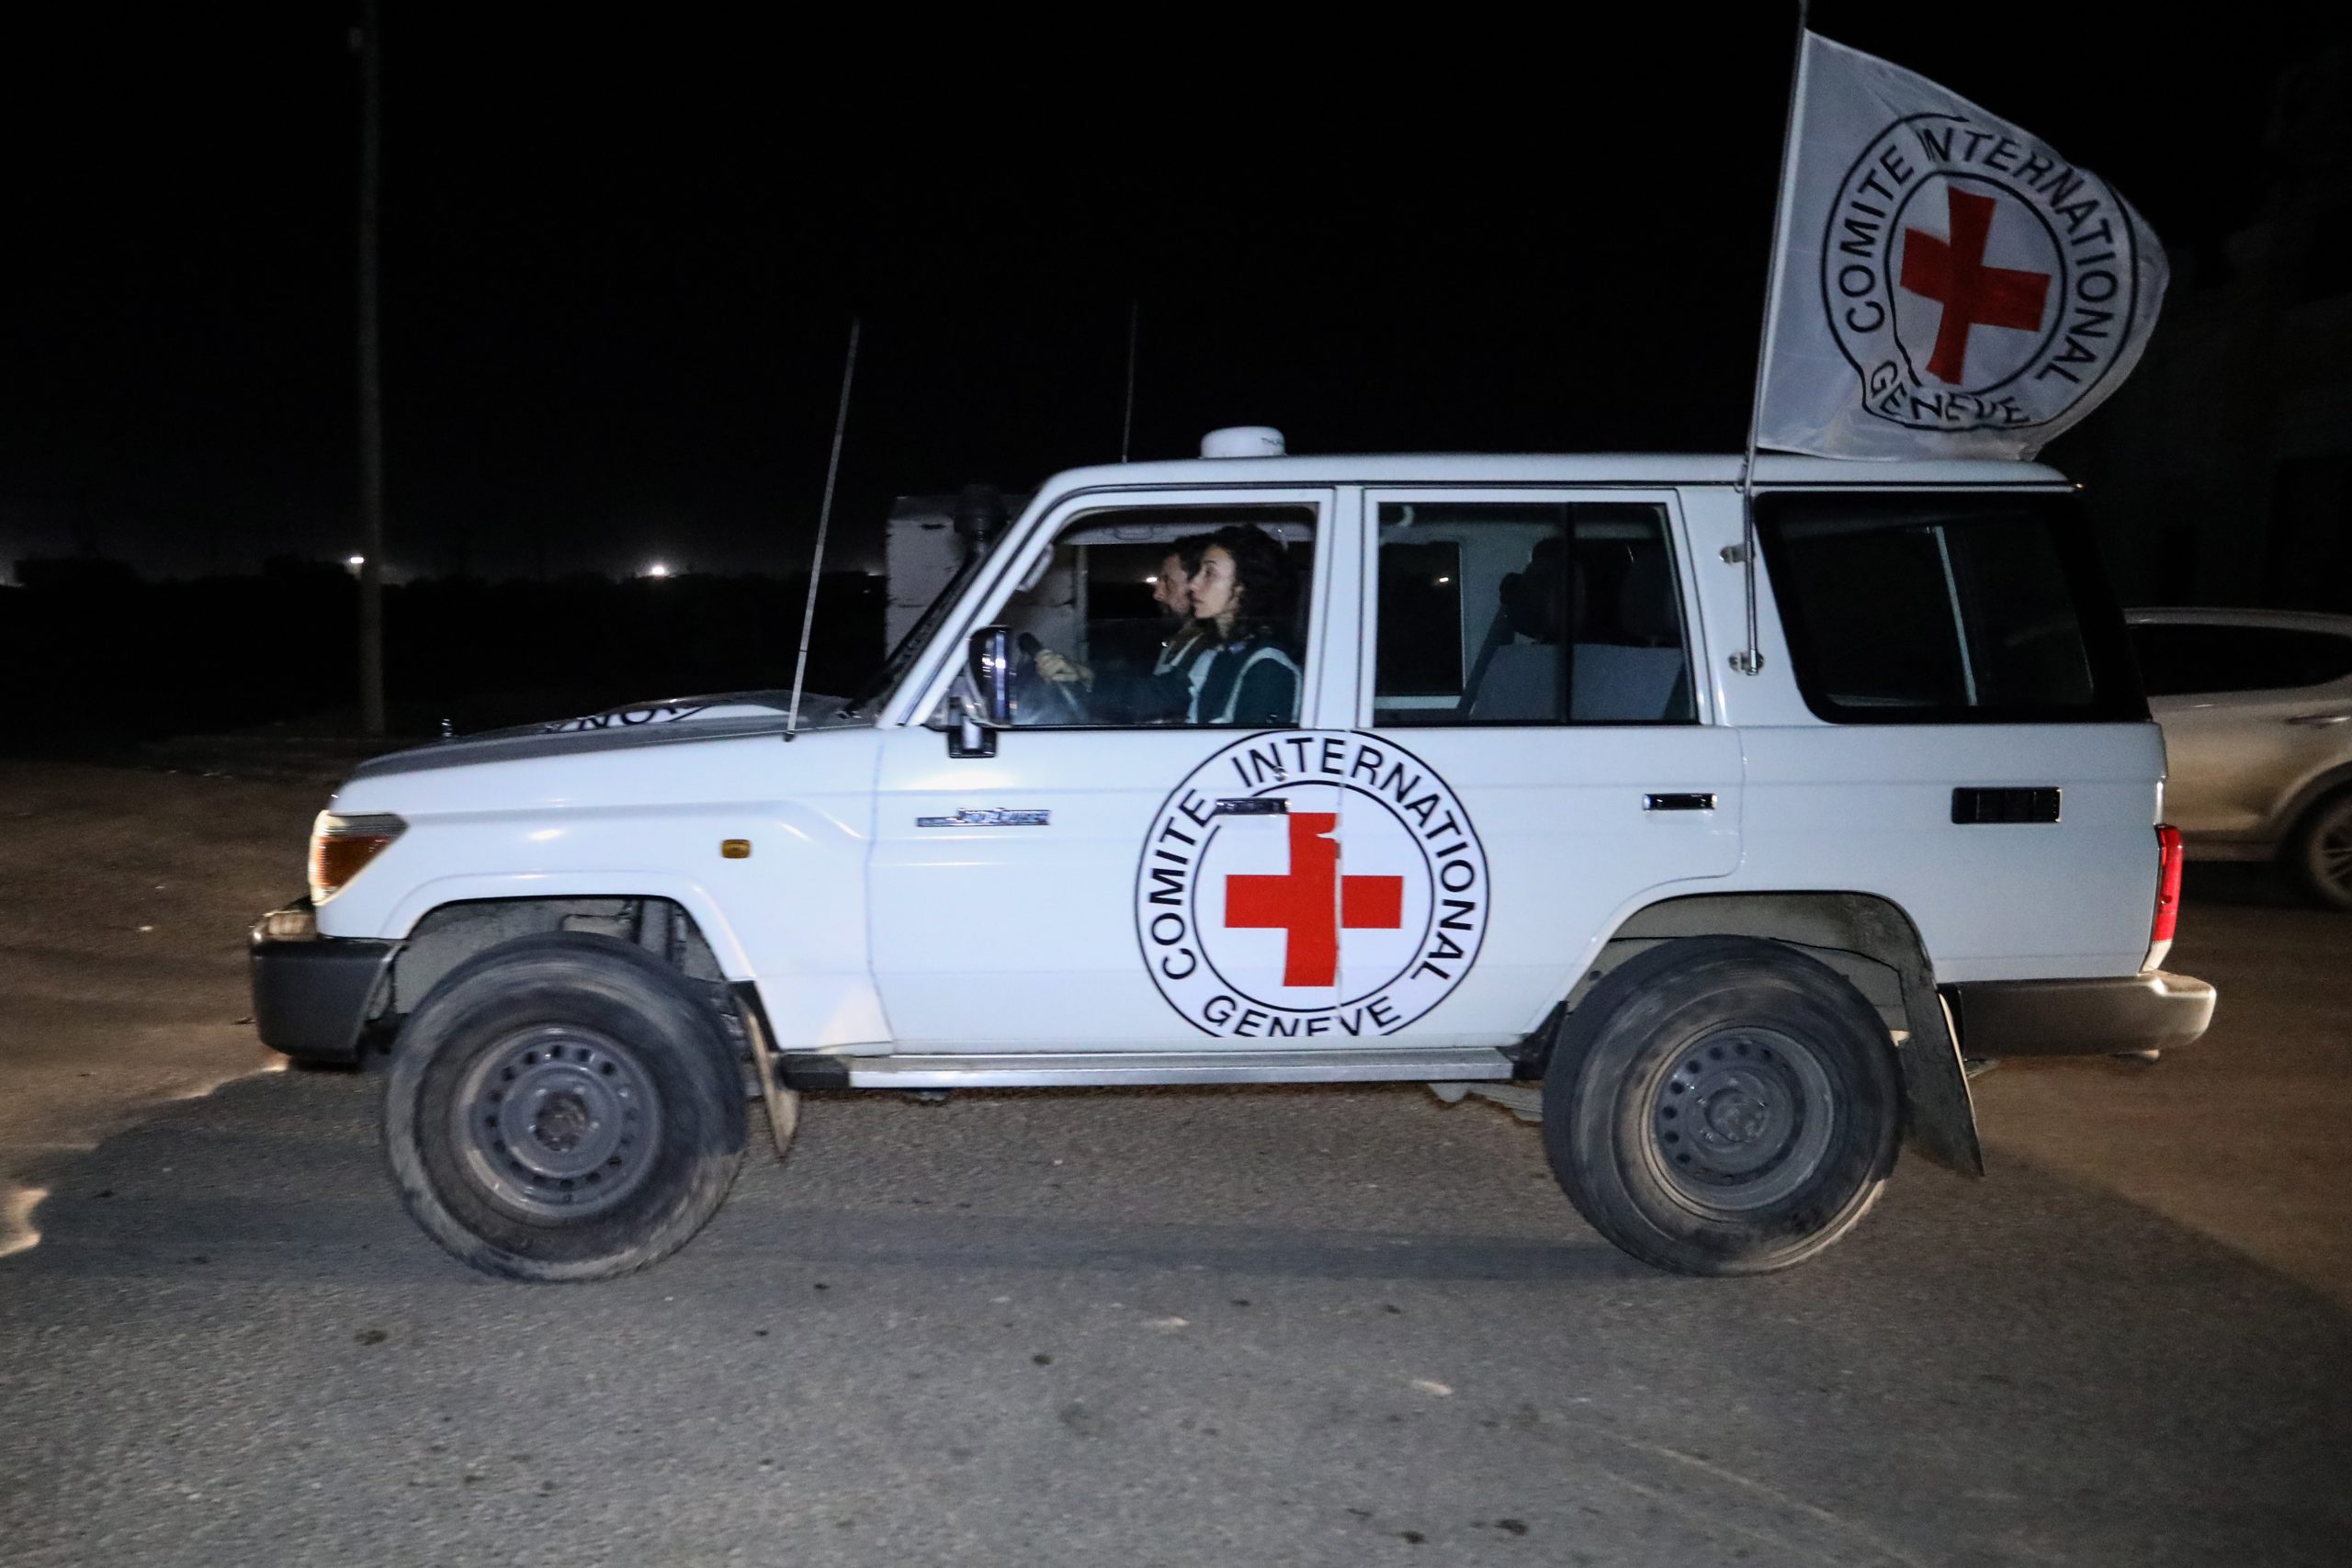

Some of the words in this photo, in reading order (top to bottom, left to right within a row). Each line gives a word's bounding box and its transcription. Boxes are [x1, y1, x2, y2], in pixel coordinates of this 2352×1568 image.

[1838, 145, 1914, 333] COMITE
[1871, 360, 2030, 423] GENEVE
[1148, 788, 1217, 980] COMITE
[1231, 737, 1476, 981] INTERNATIONAL
[1204, 995, 1402, 1037] GENEVE
